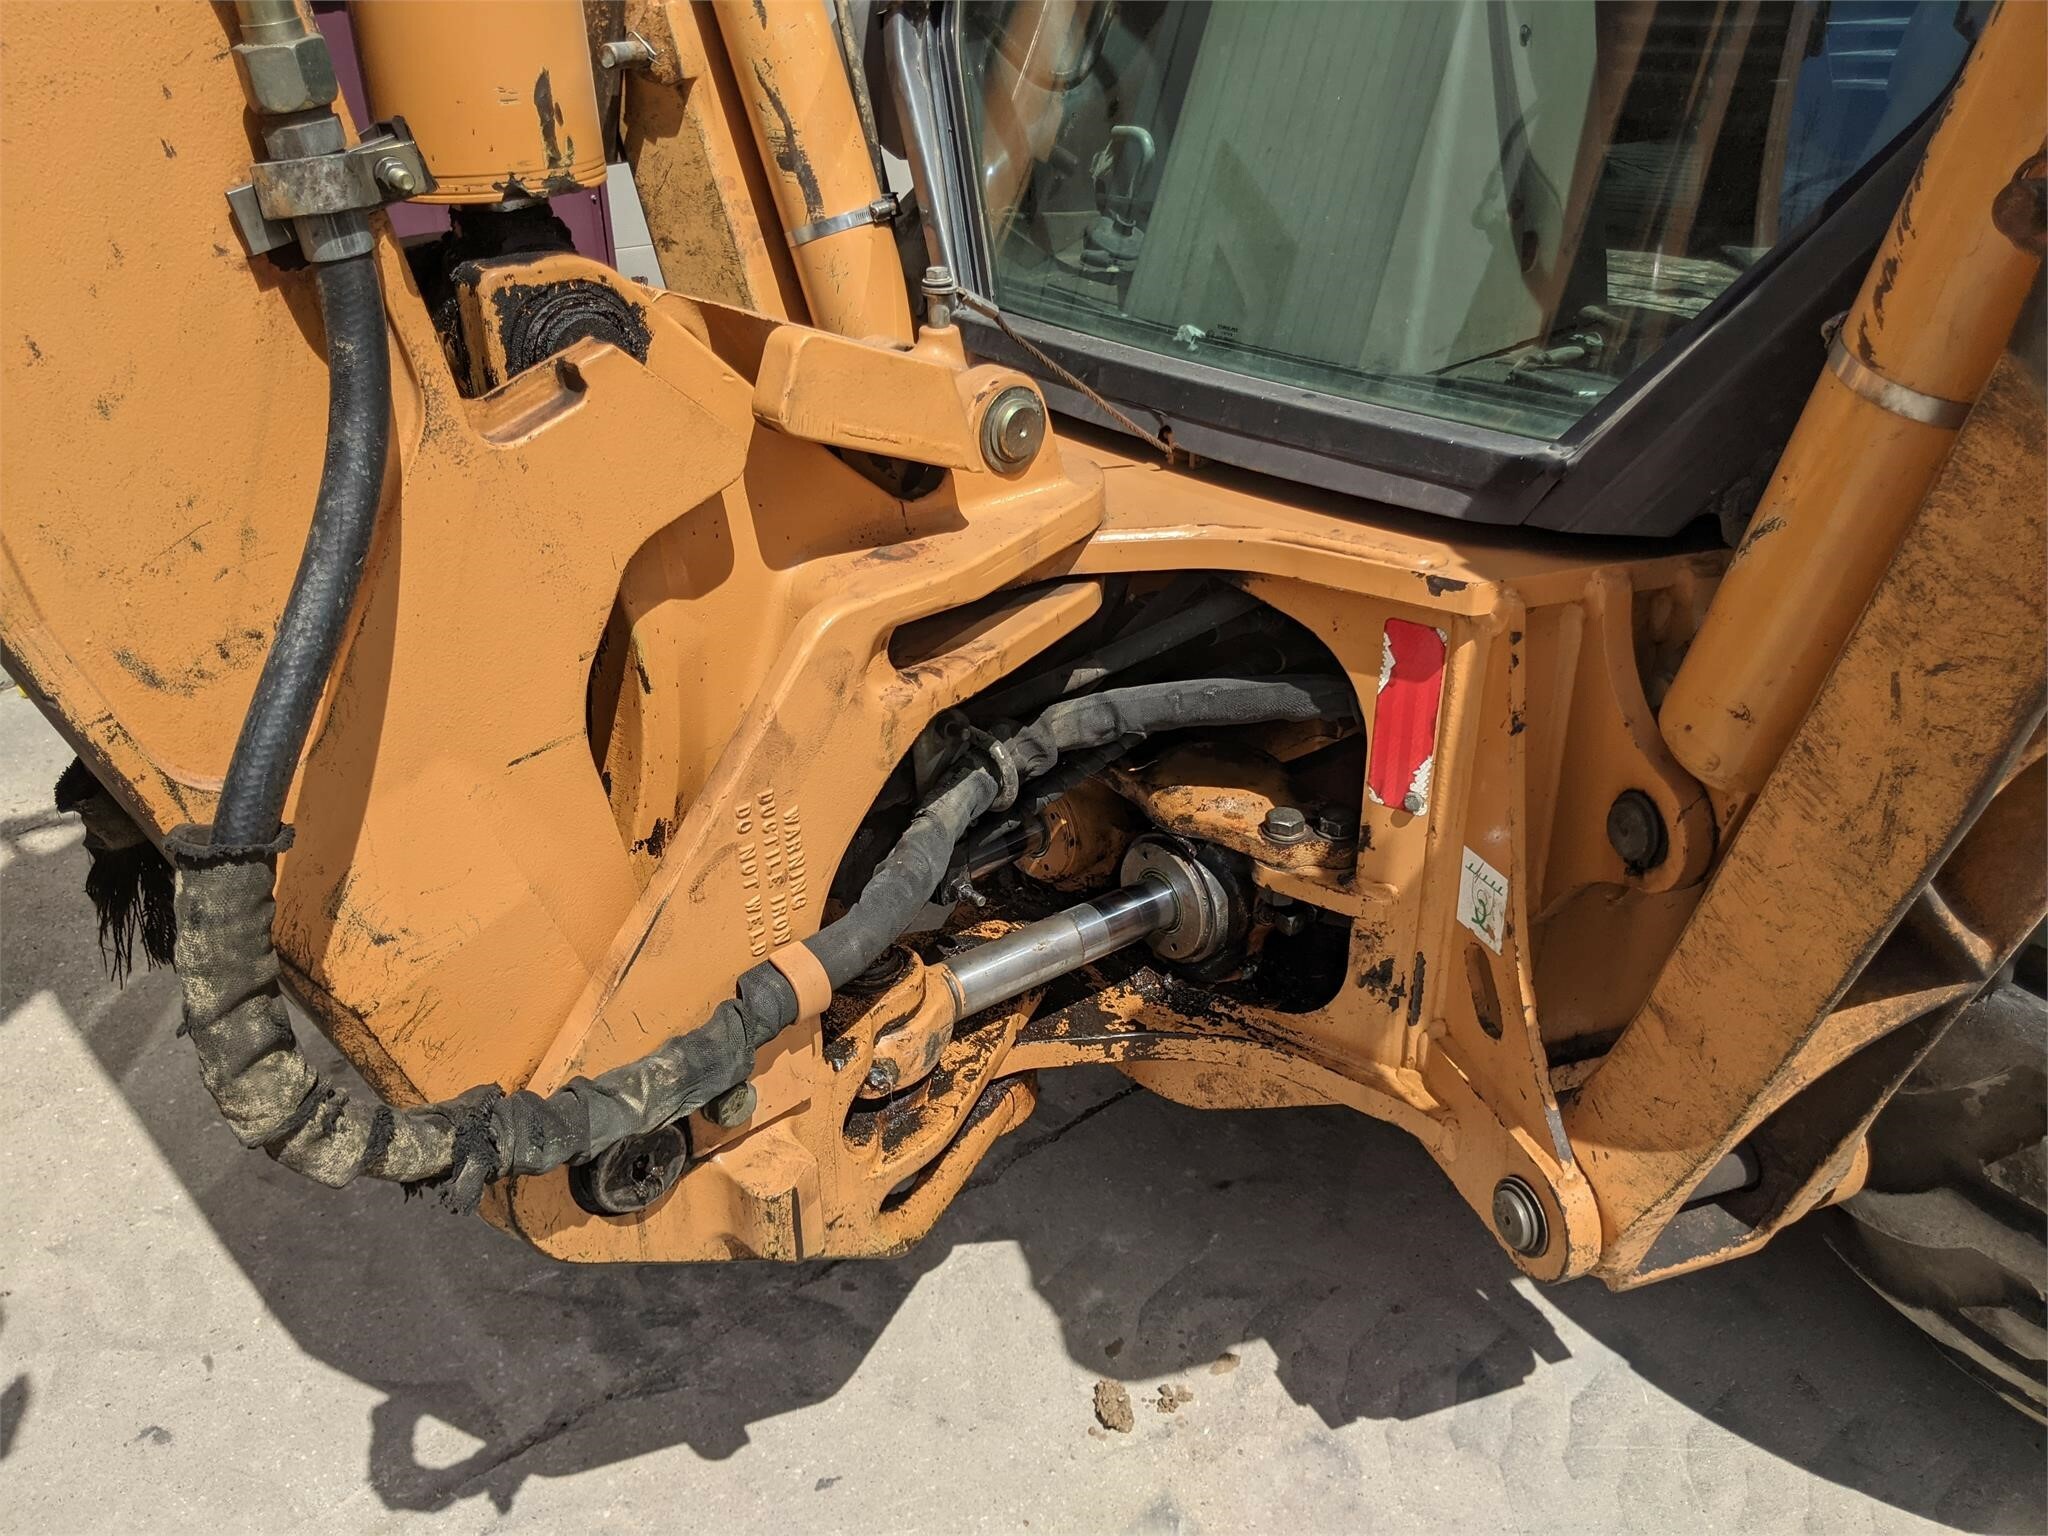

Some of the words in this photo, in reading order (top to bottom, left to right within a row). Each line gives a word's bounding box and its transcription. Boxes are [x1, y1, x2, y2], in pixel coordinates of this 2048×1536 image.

[735, 800, 753, 835] DO
[738, 842, 760, 890] NOT
[756, 788, 784, 889] DUCTILE
[770, 892, 791, 946] IRON
[783, 804, 807, 911] WARNING
[744, 895, 767, 957] WELD
